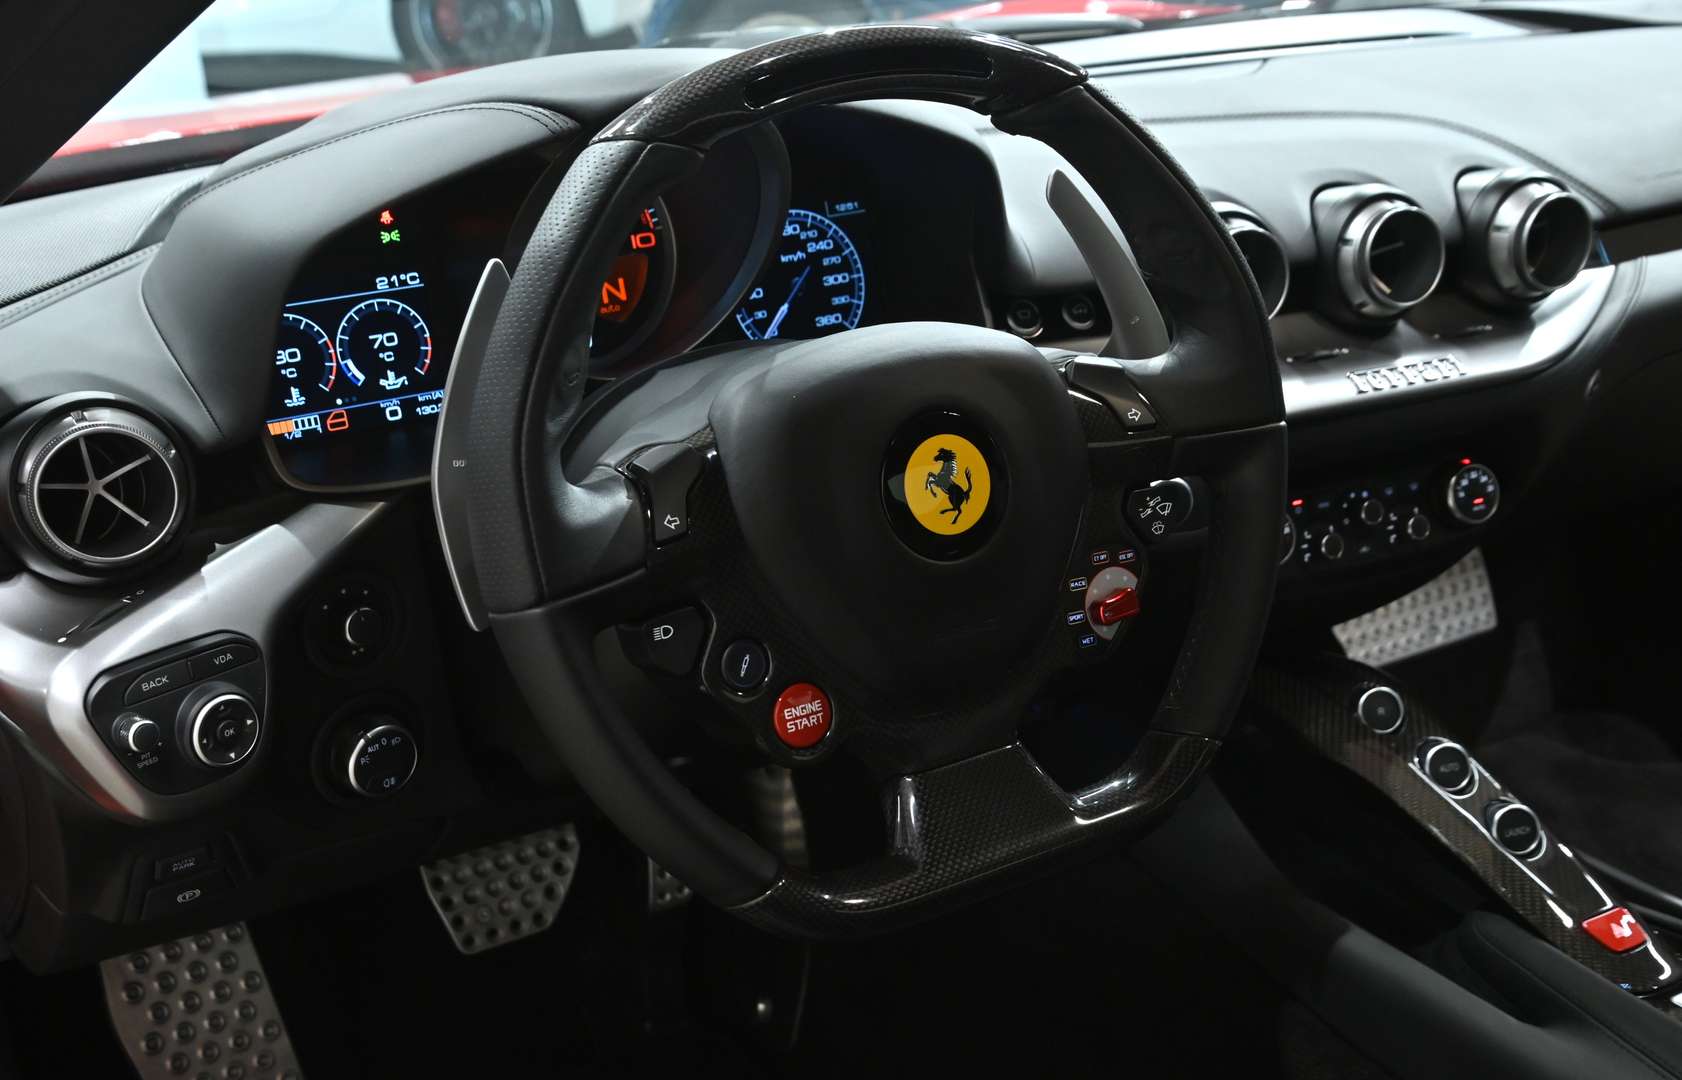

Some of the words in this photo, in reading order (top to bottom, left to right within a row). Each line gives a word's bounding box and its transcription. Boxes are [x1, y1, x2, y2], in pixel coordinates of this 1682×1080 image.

[630, 232, 656, 249] 10
[807, 239, 834, 253] 240
[780, 250, 806, 263] km/h
[823, 256, 841, 267] 270
[375, 271, 420, 290] 21°C
[823, 272, 850, 287] 300
[601, 277, 628, 304] N
[753, 310, 768, 320] 30
[815, 312, 842, 328] 360
[368, 331, 399, 350] 70
[1345, 354, 1466, 394] Ferrari
[385, 405, 402, 421] 0
[1082, 636, 1094, 645] WET
[213, 653, 233, 665] VDA
[141, 675, 169, 692] BACK
[784, 699, 823, 720] ENGINE
[786, 712, 824, 733] START
[224, 727, 236, 737] OK
